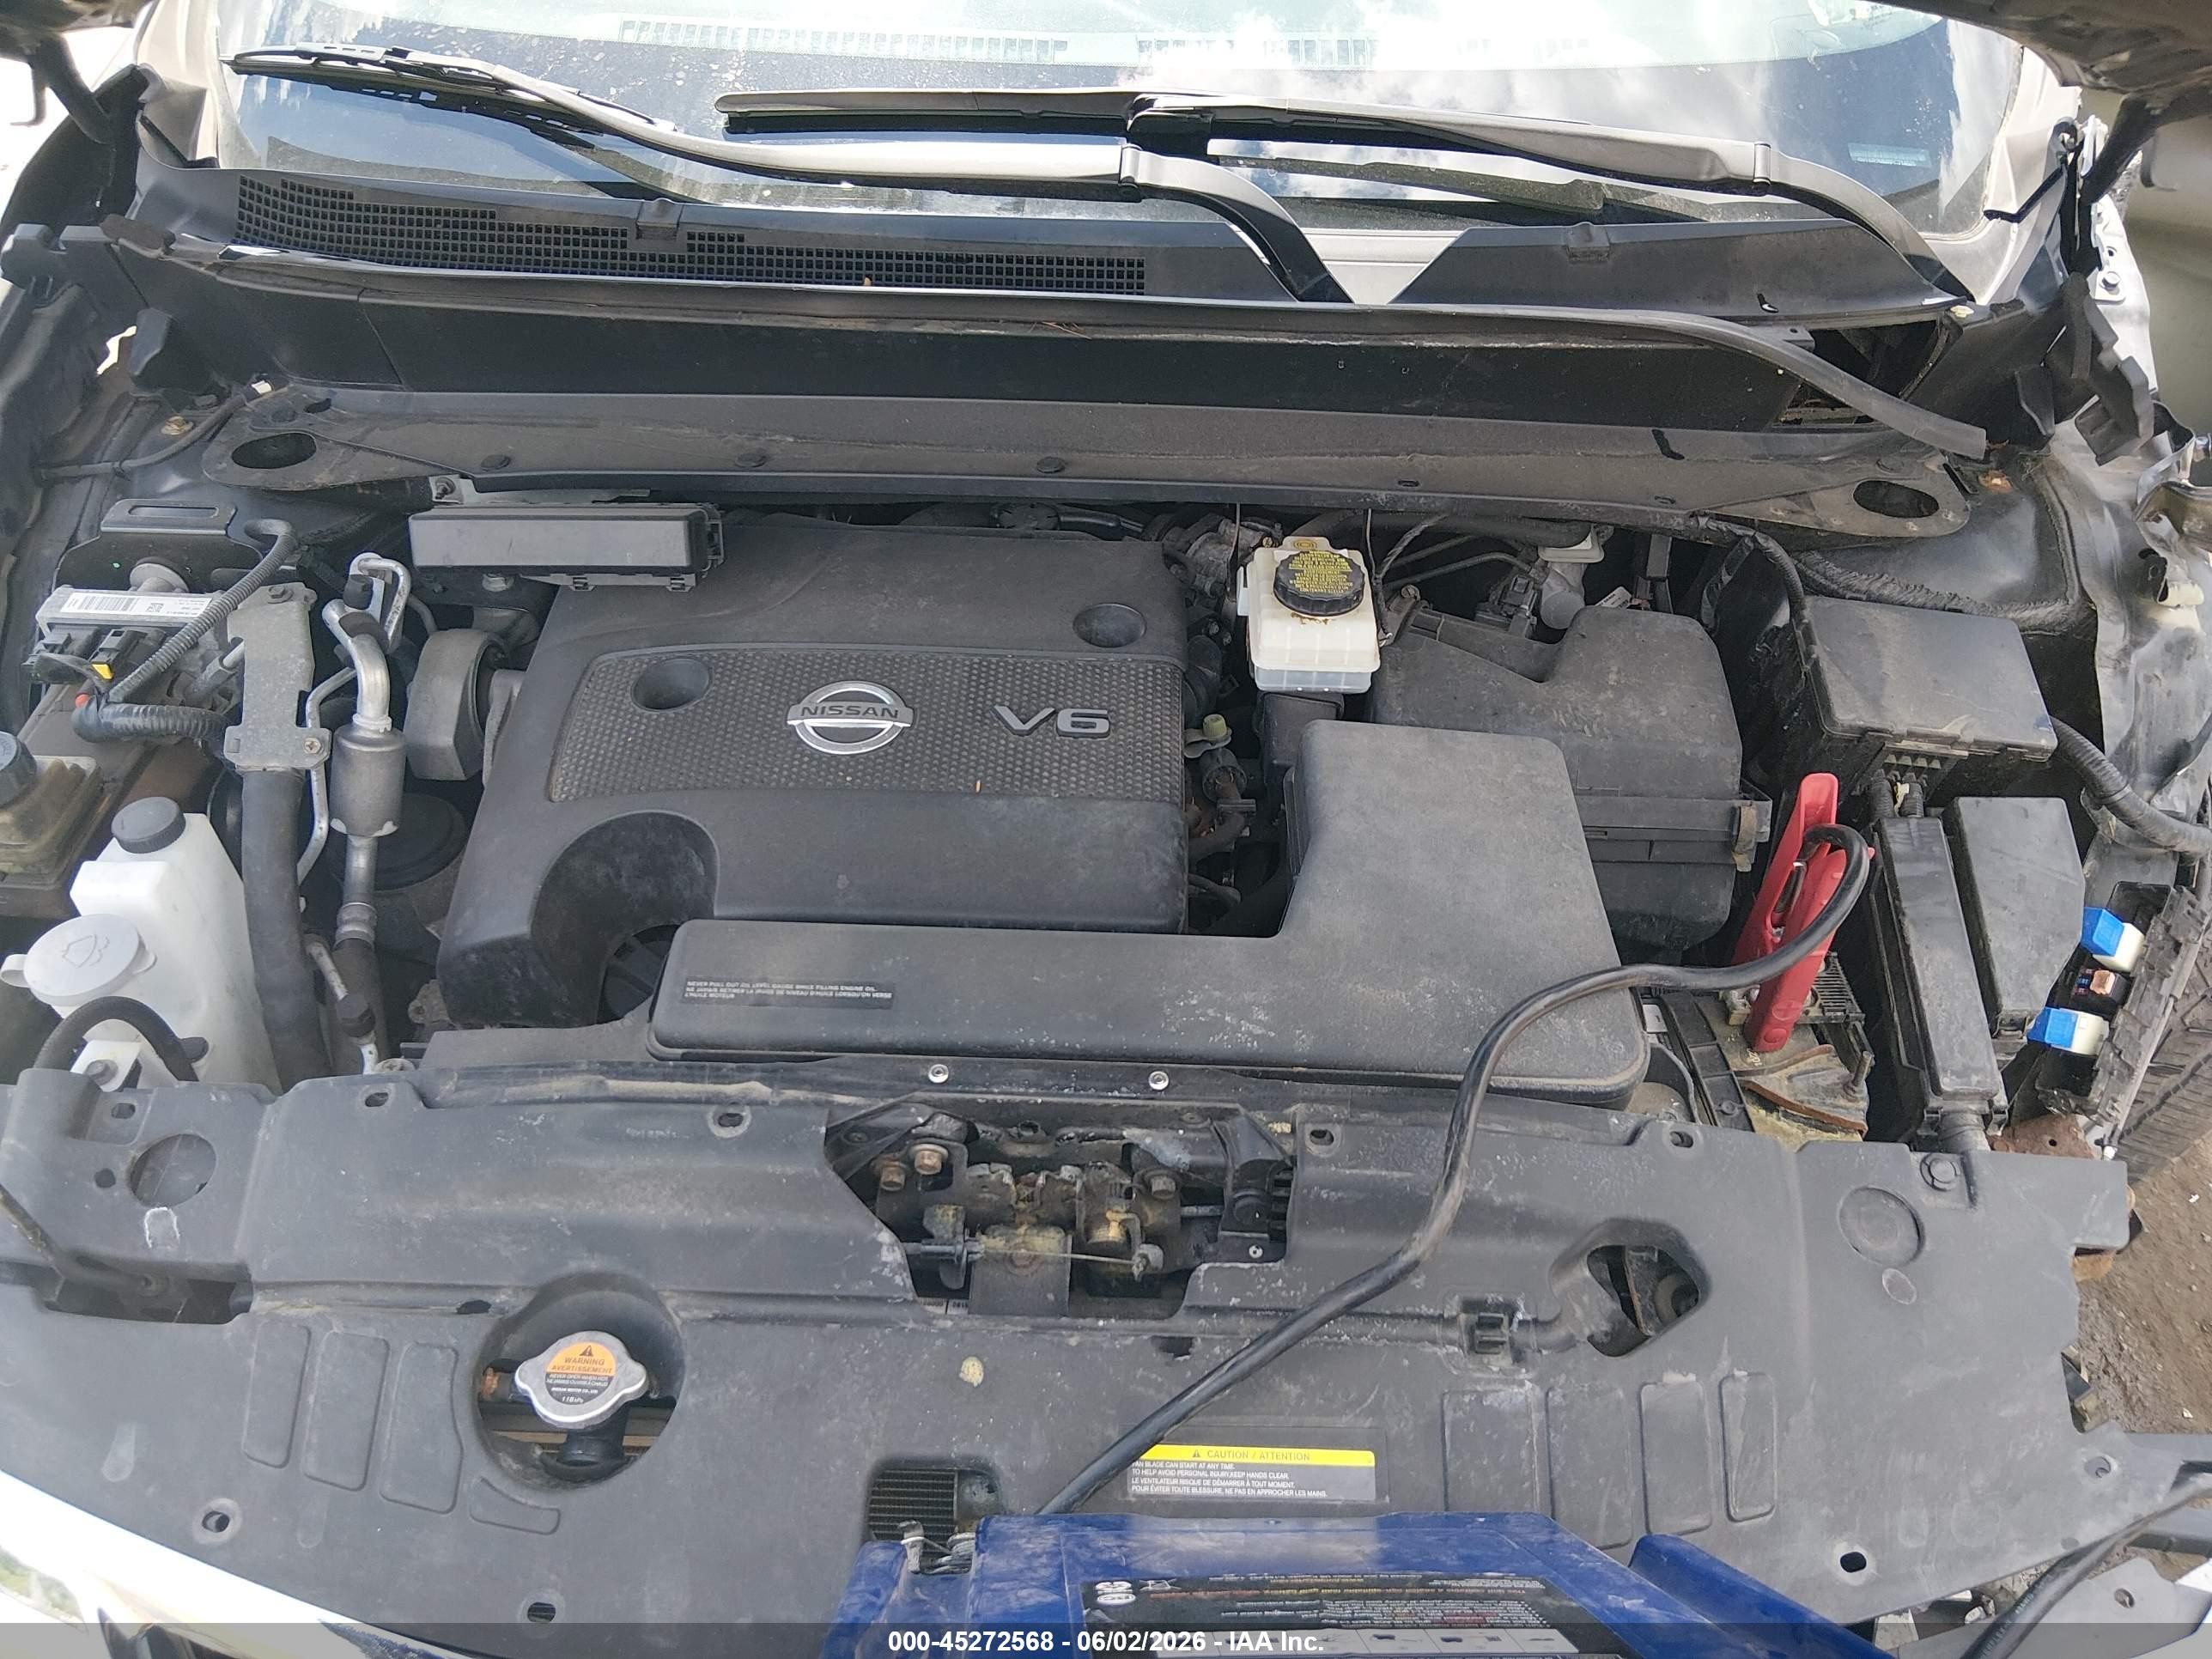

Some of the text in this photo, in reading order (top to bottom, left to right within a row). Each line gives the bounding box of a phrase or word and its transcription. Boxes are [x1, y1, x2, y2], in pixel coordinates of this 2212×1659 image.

[801, 705, 899, 718] NISSAN
[992, 705, 1110, 737] V6
[565, 1357, 605, 1365] WARNING
[552, 1365, 612, 1374] AVERTISSEMENT
[1207, 1449, 1248, 1459] CAUTION
[1259, 1451, 1310, 1461] ATTENTION
[1212, 1477, 1244, 1486] DÉMARRER
[1151, 1483, 1170, 1492] ÉVITER
